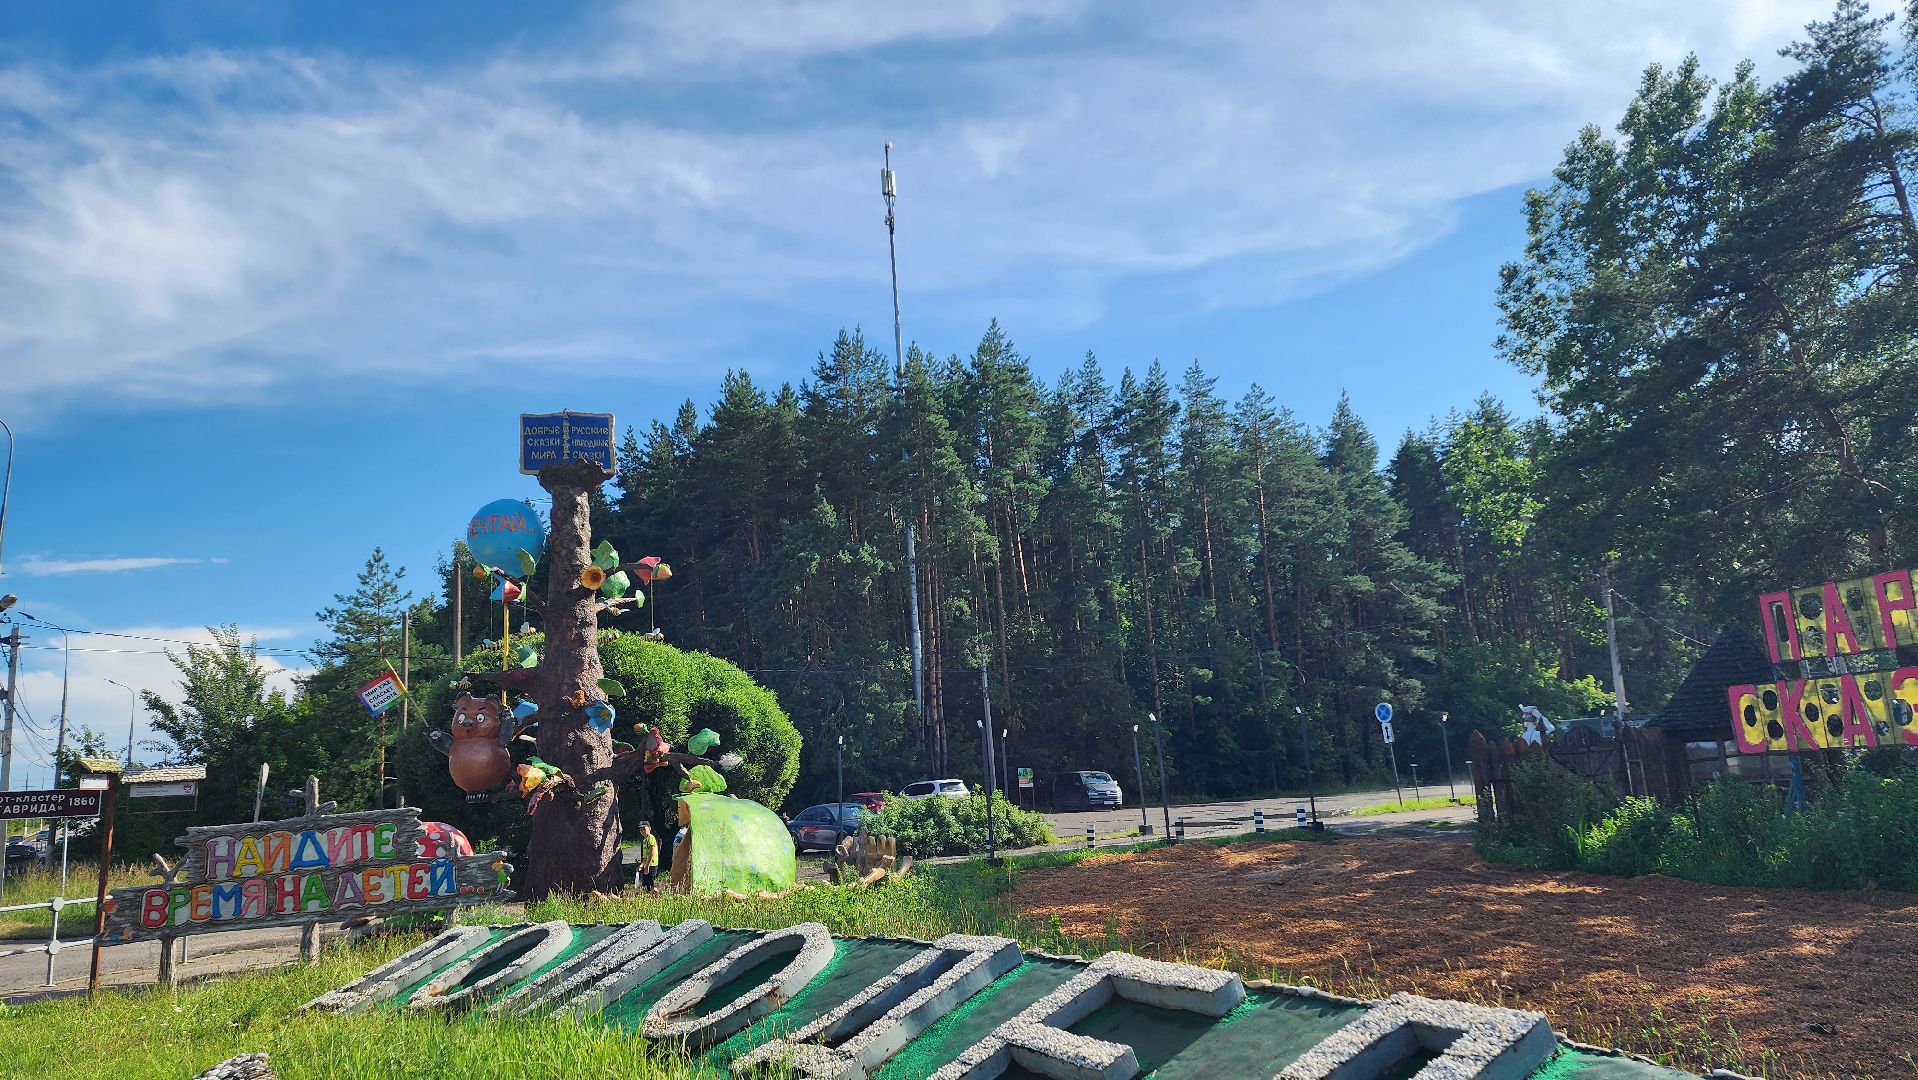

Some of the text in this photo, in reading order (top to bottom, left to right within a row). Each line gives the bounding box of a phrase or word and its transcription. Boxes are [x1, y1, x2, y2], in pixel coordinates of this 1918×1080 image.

[524, 426, 560, 436] ДОБРЫЕ
[571, 426, 609, 435] РУССКИЕ
[527, 438, 560, 447] СКАЗКИ
[571, 439, 609, 448] НАРОДНЫЕ
[531, 450, 557, 460] МИРА
[572, 450, 605, 460] СКАЗКИ
[68, 796, 95, 807] 1860
[208, 823, 398, 880] НАЙДИТЕ
[142, 879, 267, 928] ВРЕМЯ
[275, 873, 331, 915] НА
